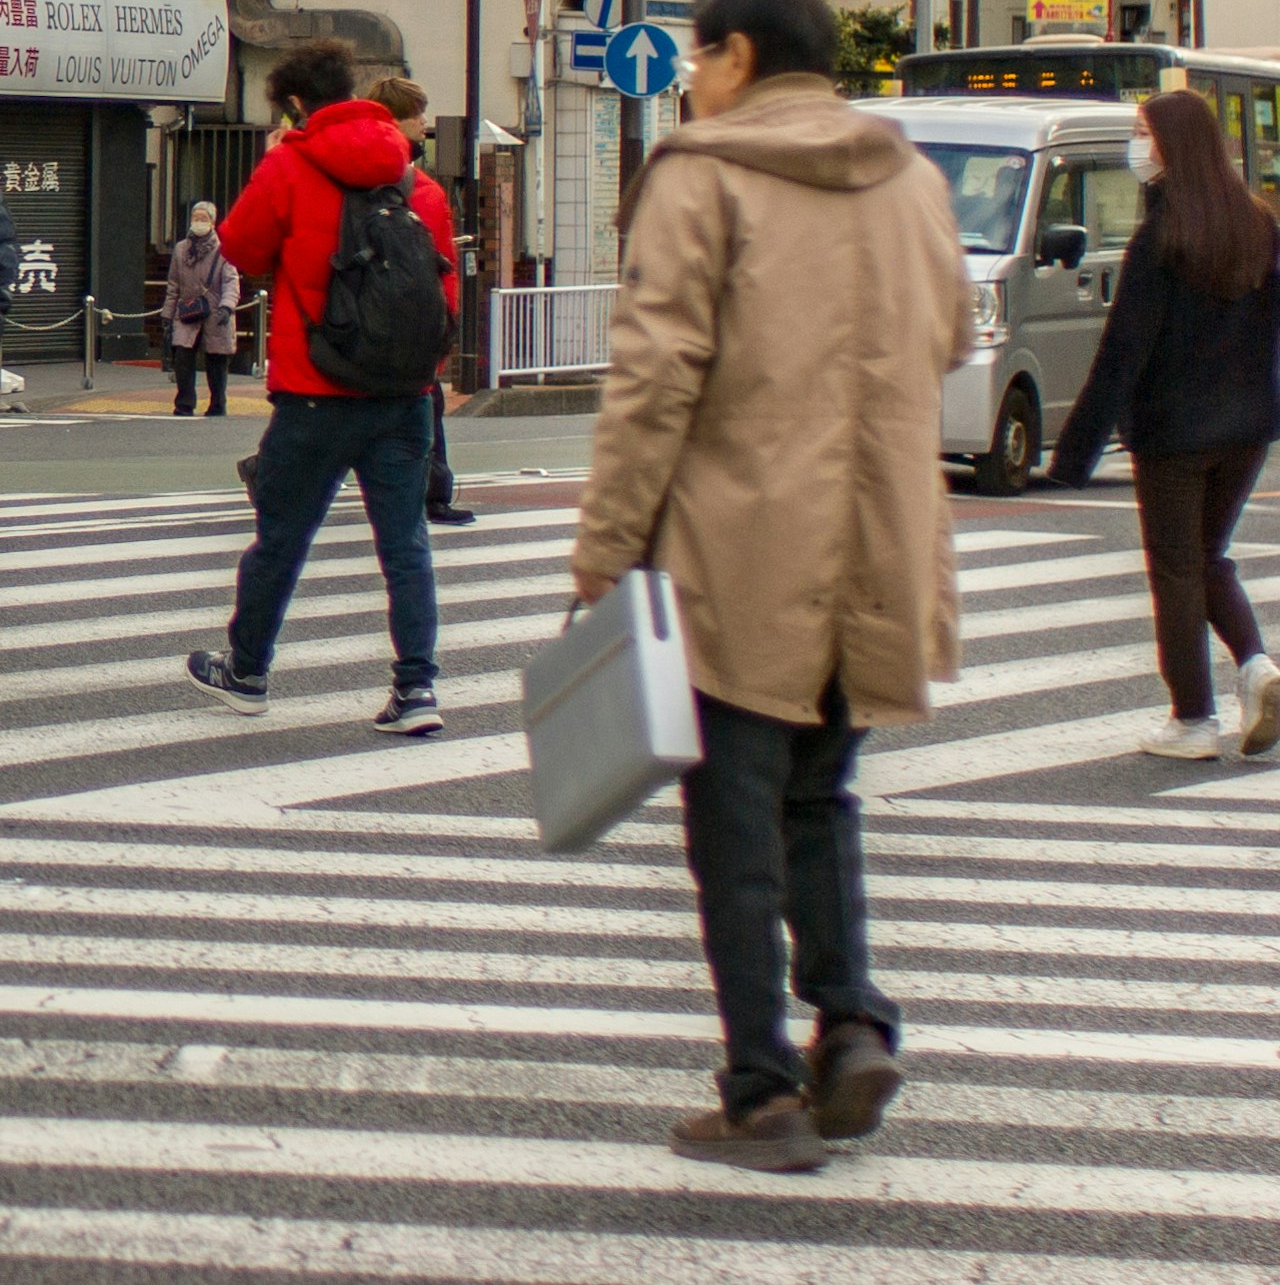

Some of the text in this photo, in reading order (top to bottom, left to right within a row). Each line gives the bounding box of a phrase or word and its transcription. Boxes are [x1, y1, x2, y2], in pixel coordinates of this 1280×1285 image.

[45, 1, 103, 33] ROLEX
[180, 14, 225, 80] OMEGA
[55, 55, 178, 87] LOUIS VUITTON
